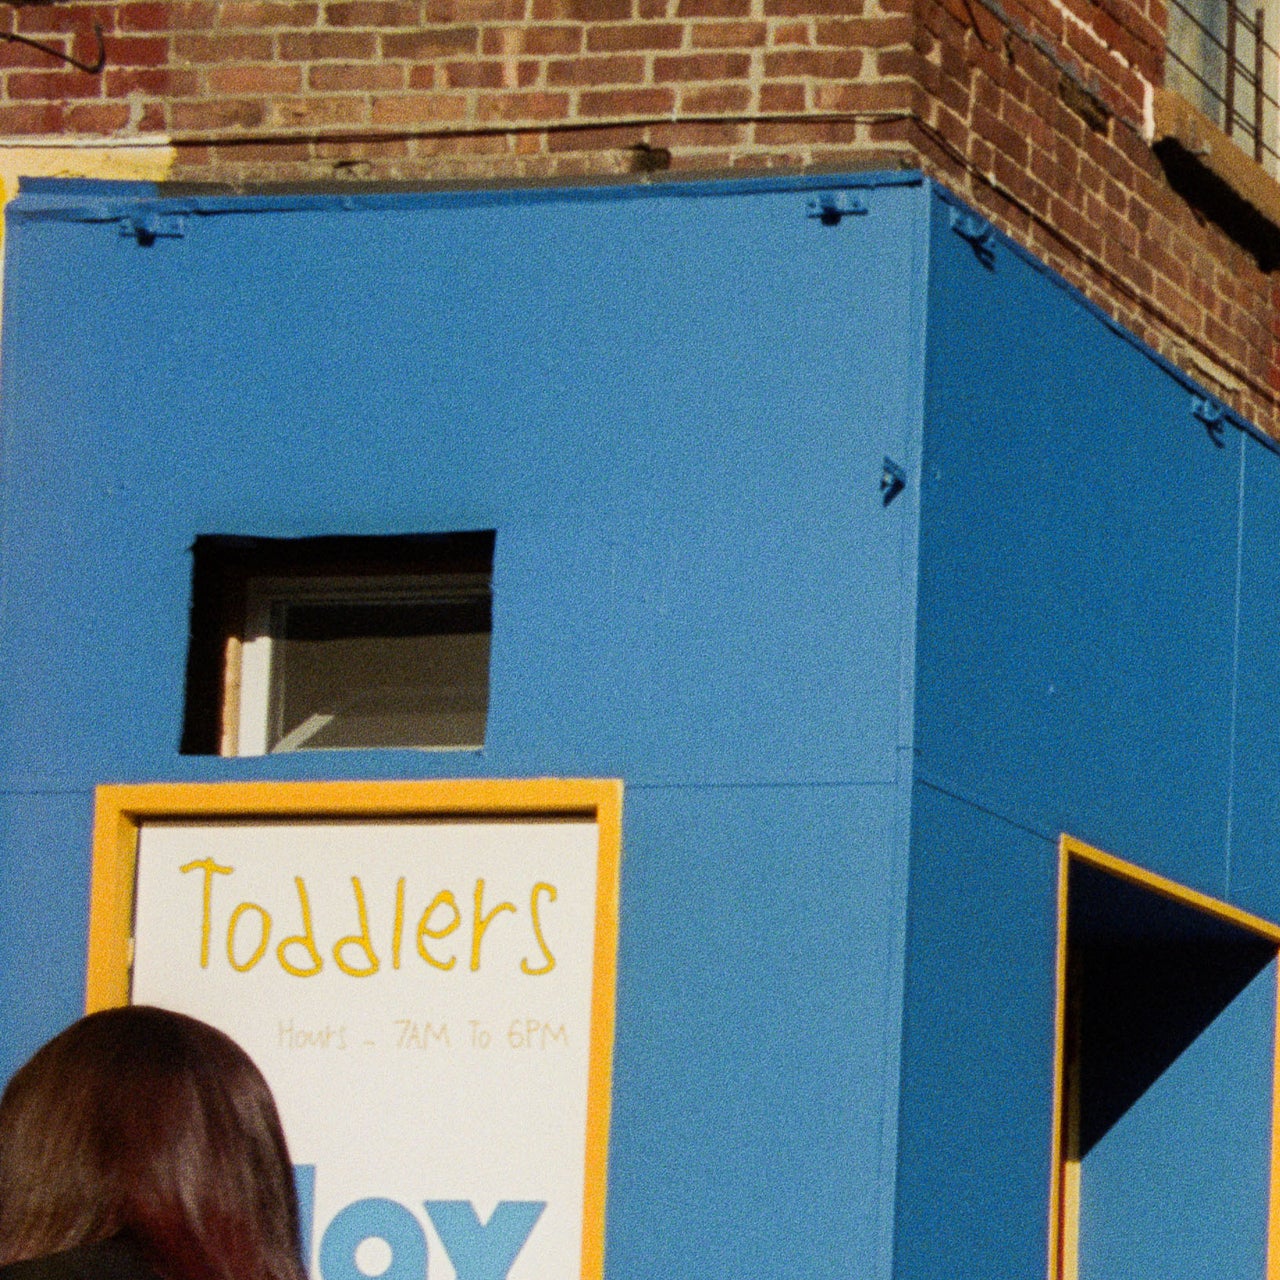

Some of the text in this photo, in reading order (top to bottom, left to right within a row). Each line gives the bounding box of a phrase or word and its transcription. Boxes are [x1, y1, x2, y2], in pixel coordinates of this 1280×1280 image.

[179, 856, 558, 978] Toddlers
[394, 1018, 450, 1051] 7AM
[506, 1018, 570, 1051] 6PM
